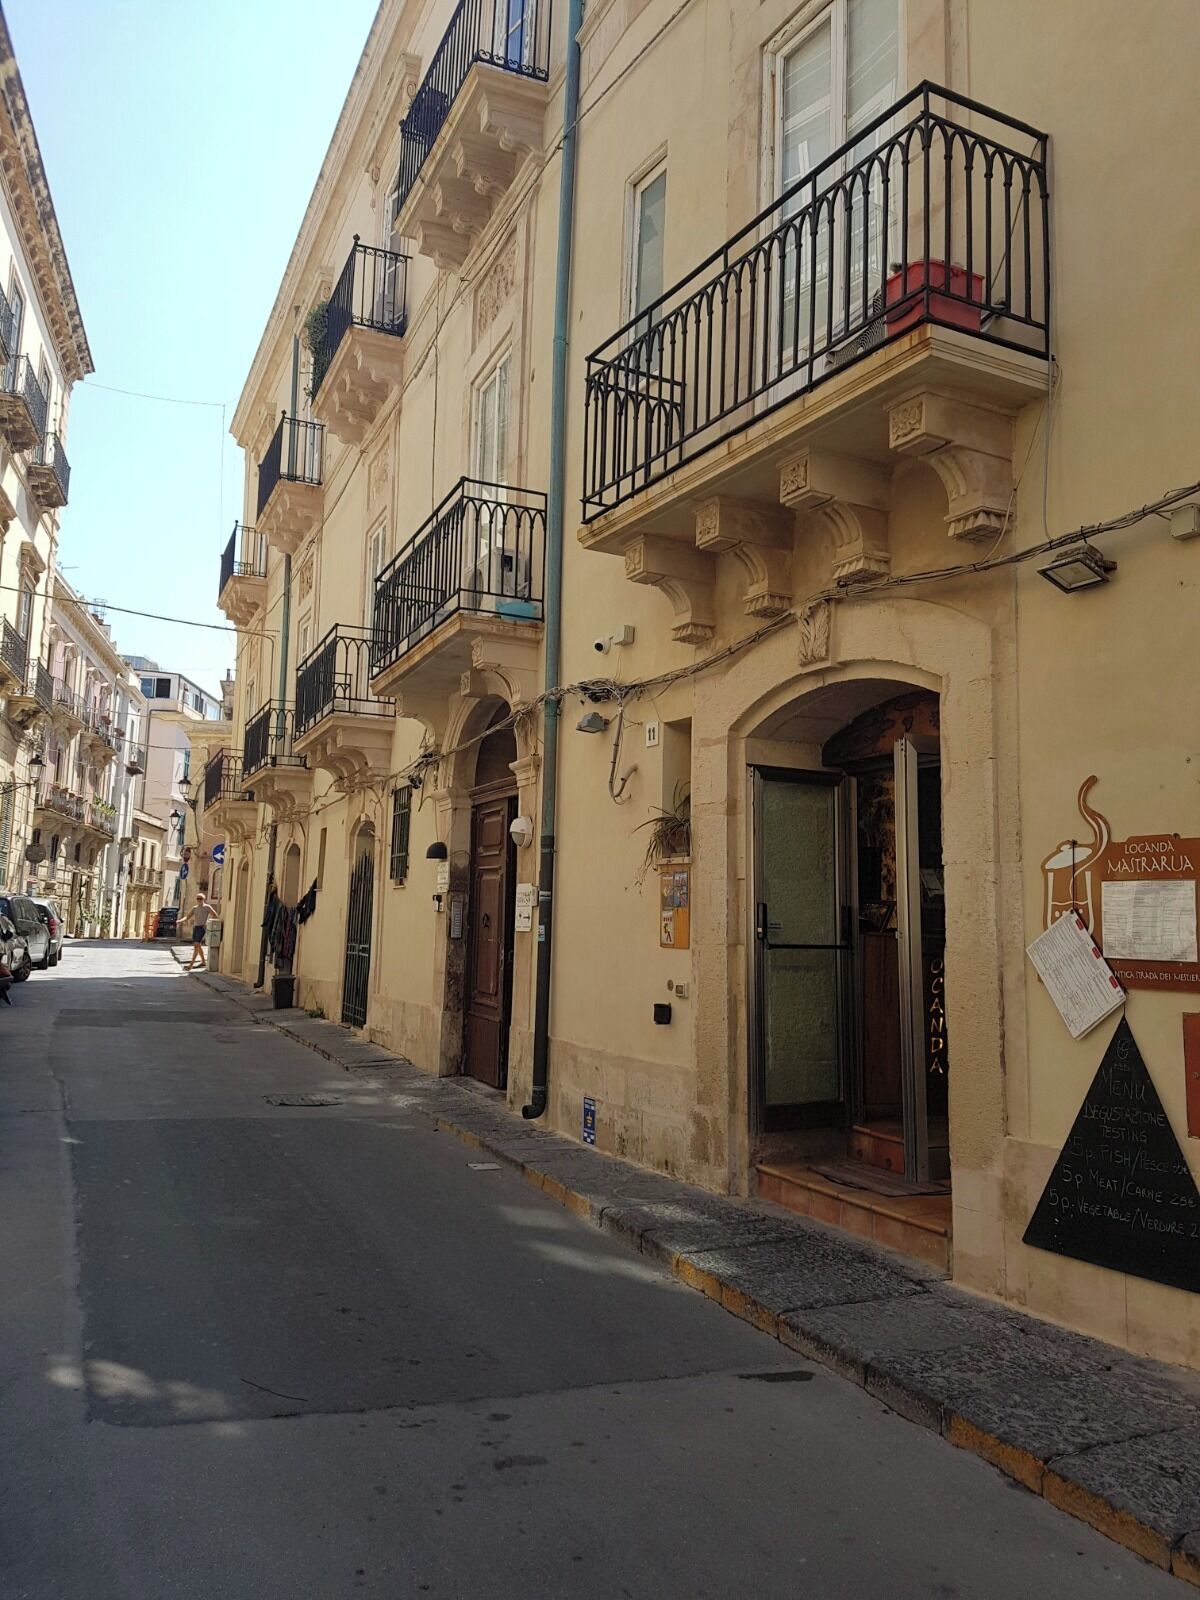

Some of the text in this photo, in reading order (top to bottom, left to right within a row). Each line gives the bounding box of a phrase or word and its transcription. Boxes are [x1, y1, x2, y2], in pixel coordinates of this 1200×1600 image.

[648, 726, 656, 741] 11
[1124, 840, 1175, 855] LOCANDA
[1107, 855, 1194, 874] MASTRARUA
[1114, 970, 1134, 979] NTICA
[1135, 971, 1159, 981] STRADA
[1159, 972, 1171, 981] DEI
[1099, 1125, 1148, 1145] TESTING
[1190, 1222, 1200, 1238] 2
